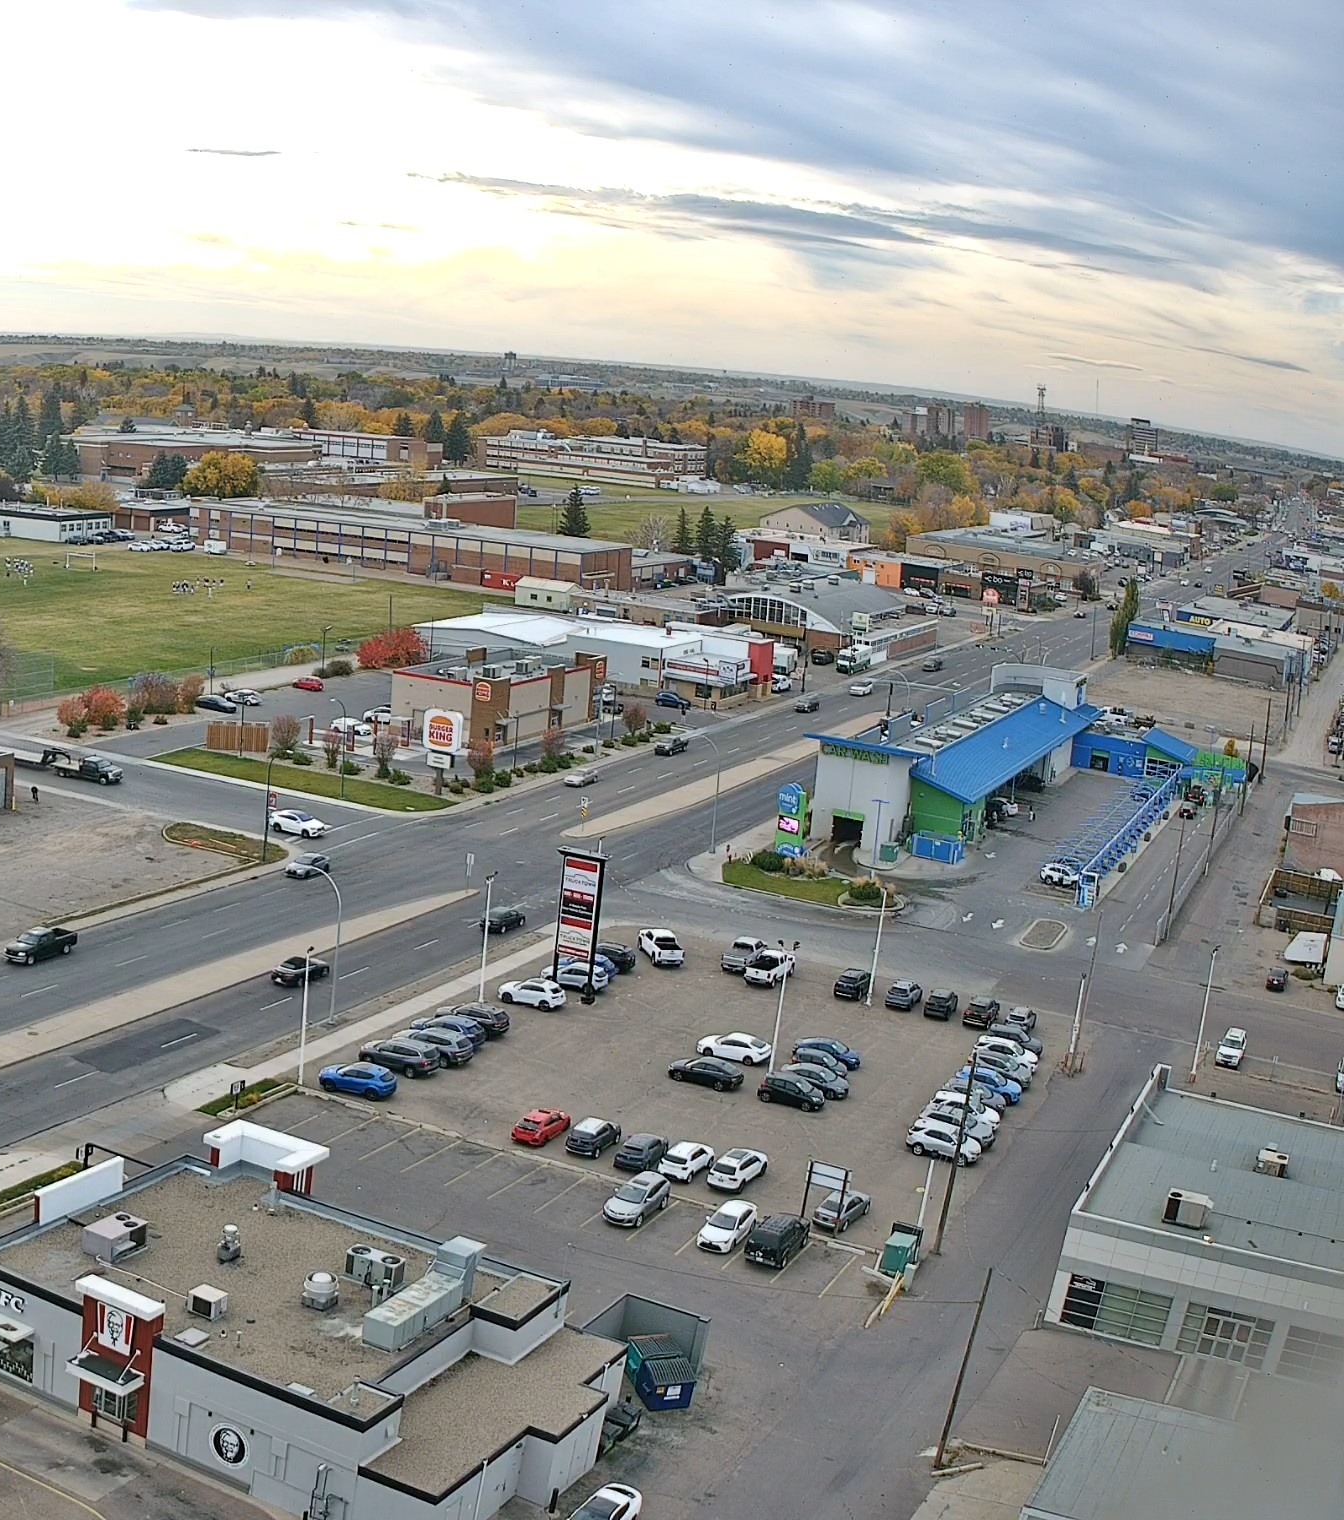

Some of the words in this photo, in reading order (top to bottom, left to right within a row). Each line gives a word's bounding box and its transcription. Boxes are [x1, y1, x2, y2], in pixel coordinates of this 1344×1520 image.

[1189, 615, 1211, 626] AUTO
[429, 723, 453, 733] BURGER
[429, 731, 453, 742] KING
[821, 744, 847, 757] CAR
[851, 748, 889, 765] WASH
[779, 791, 797, 804] mint
